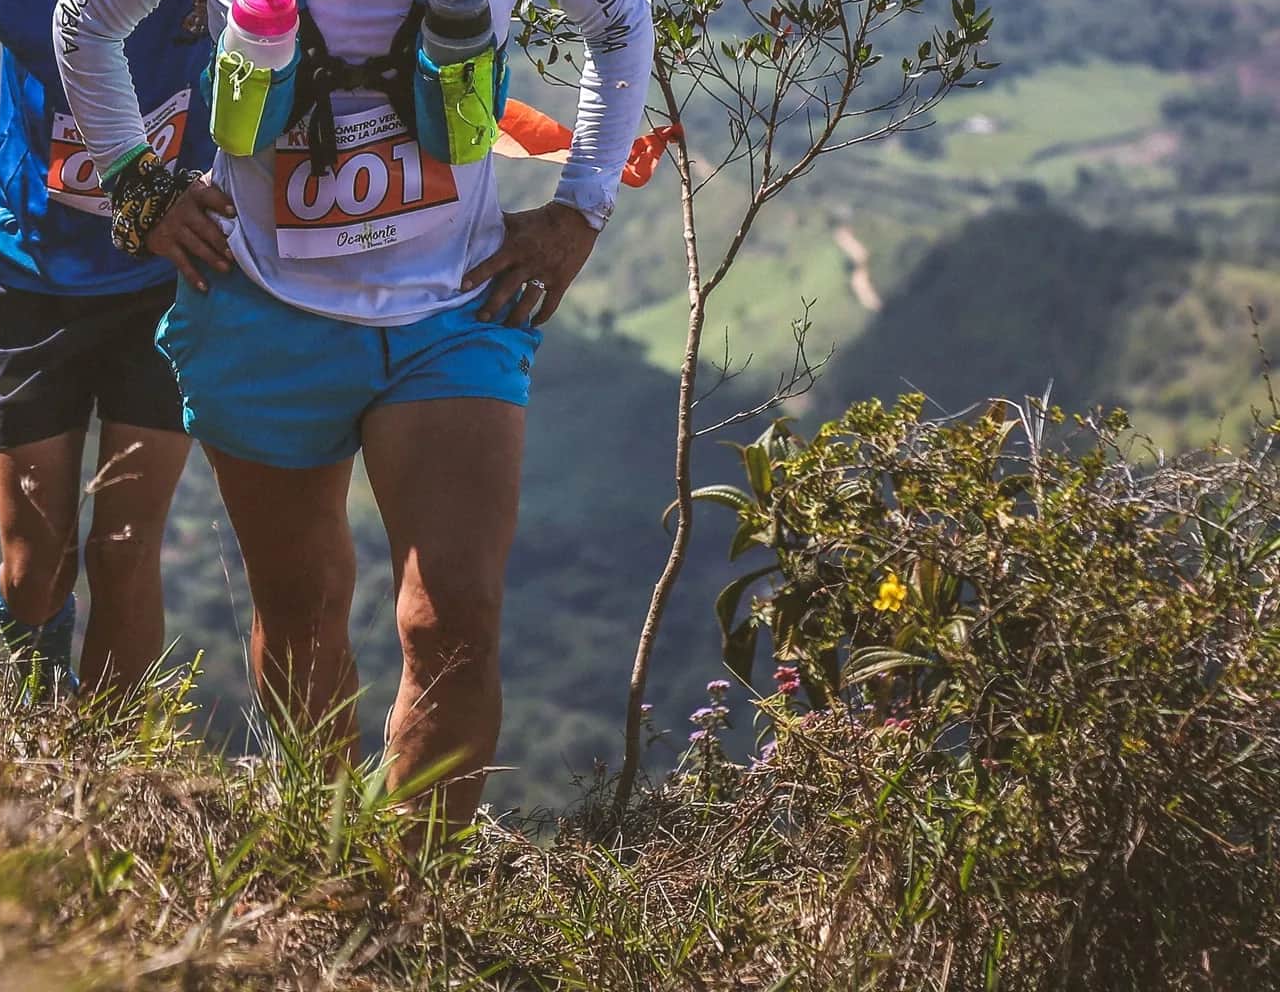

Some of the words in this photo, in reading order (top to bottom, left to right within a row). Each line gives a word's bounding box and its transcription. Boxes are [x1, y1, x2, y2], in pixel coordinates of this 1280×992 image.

[336, 119, 377, 135] ÓMETRO
[336, 134, 356, 145] RRO
[358, 130, 370, 140] LA
[371, 121, 407, 136] JABON
[287, 140, 423, 221] 001
